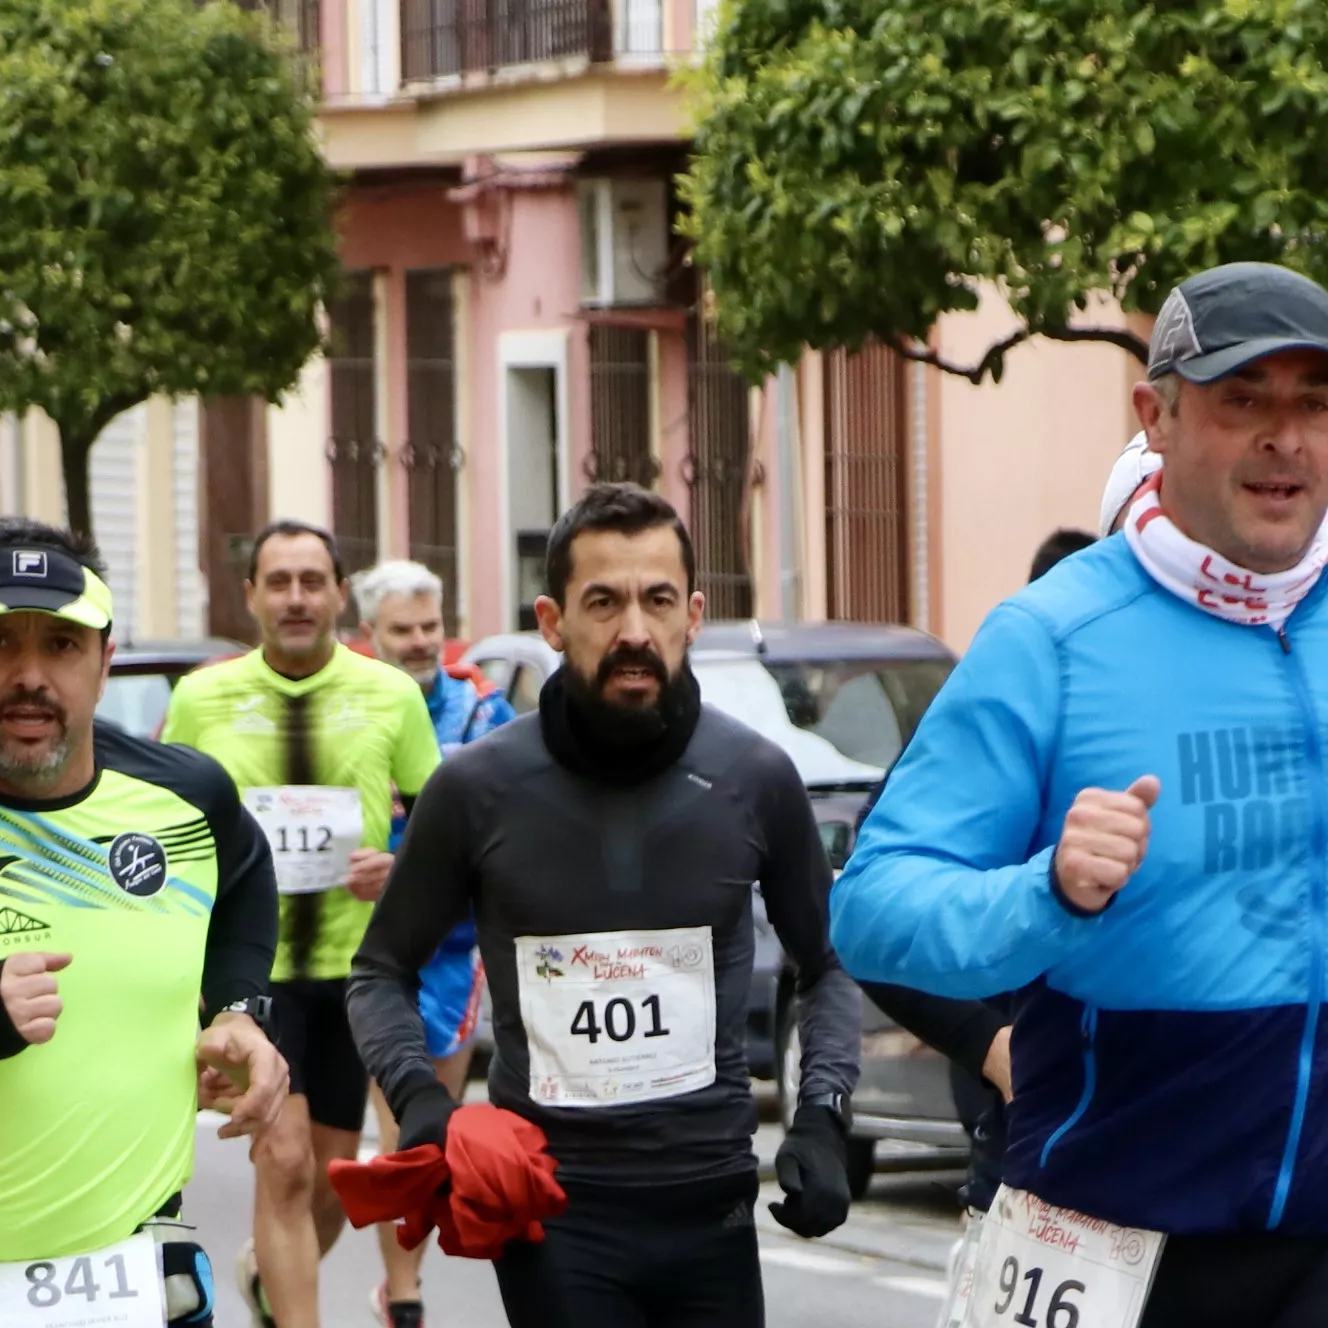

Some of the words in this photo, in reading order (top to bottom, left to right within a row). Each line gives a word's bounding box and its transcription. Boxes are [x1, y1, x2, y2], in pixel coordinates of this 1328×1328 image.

[276, 825, 333, 852] 112
[594, 963, 647, 980] LUCENA
[570, 994, 670, 1044] 401
[1028, 1214, 1088, 1253] LUCENA
[25, 1254, 138, 1308] 841
